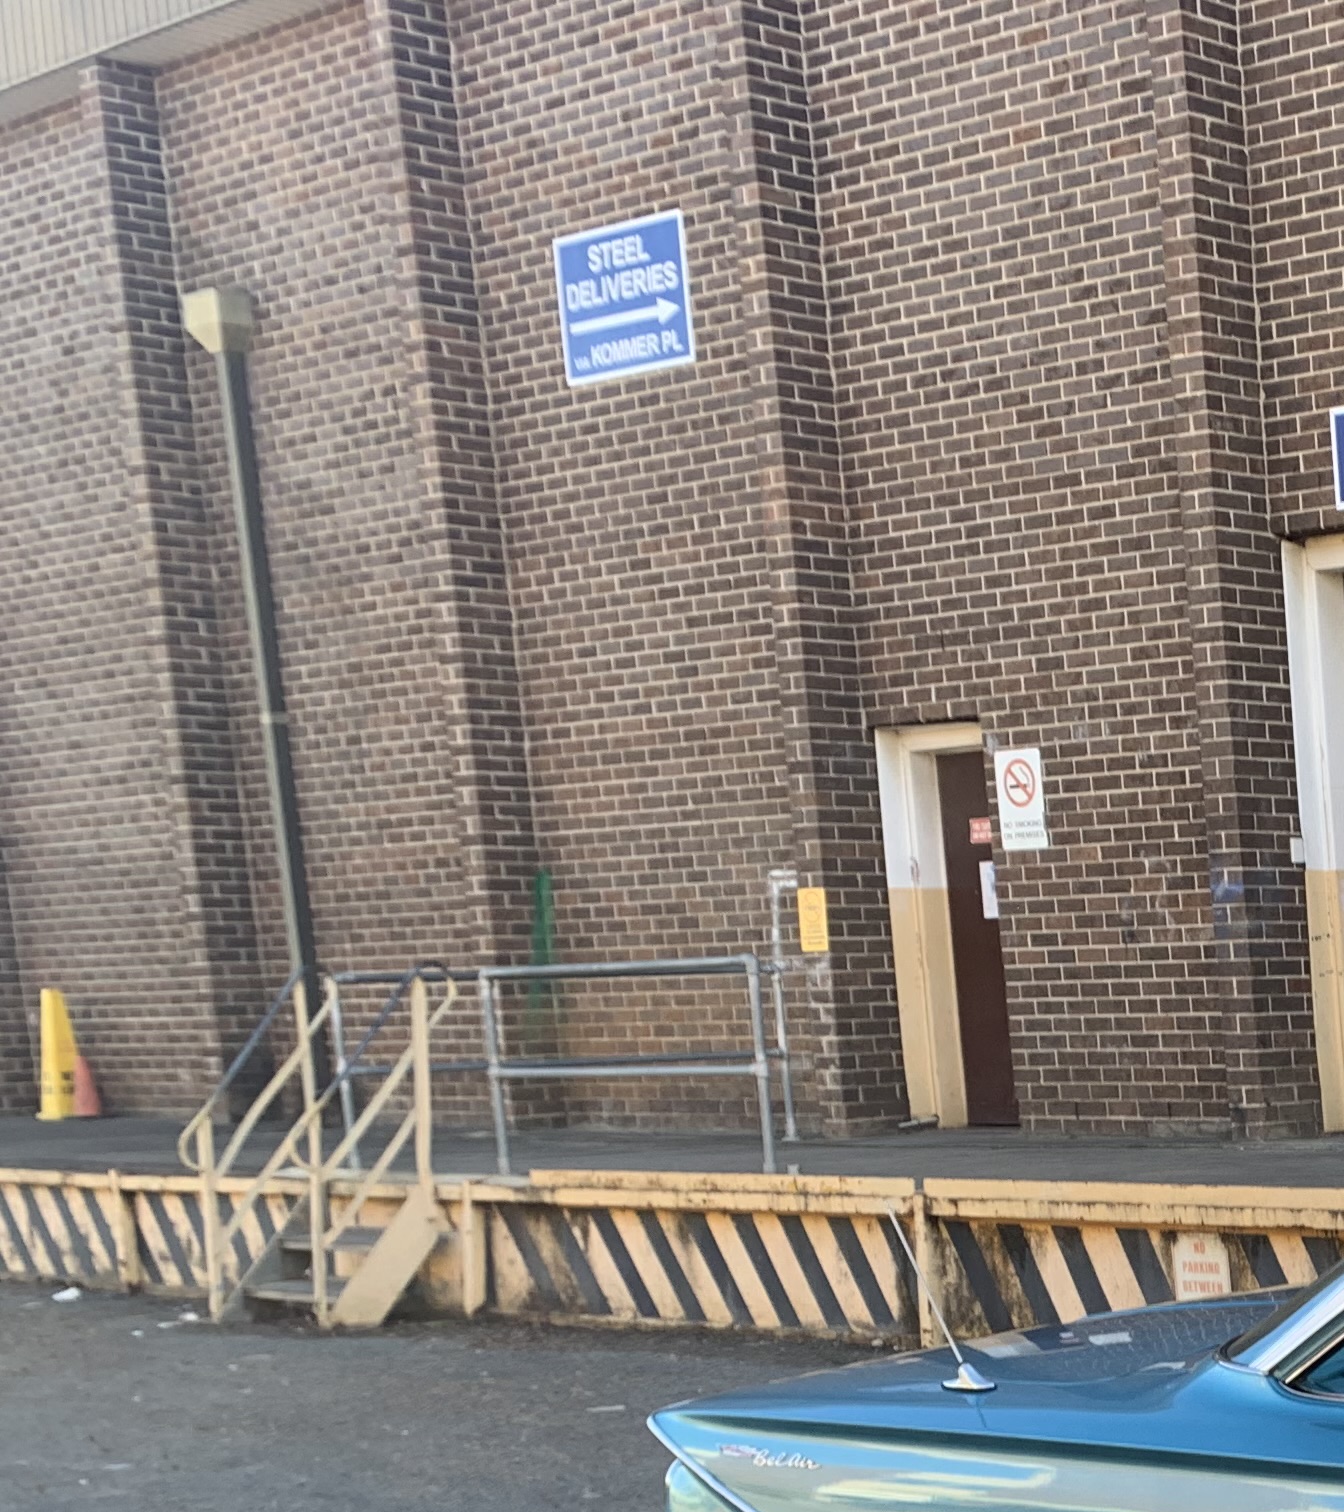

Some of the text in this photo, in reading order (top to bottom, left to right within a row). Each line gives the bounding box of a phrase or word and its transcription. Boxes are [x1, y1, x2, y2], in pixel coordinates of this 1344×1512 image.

[587, 234, 651, 274] STEEL
[565, 260, 679, 313] DELIVERIES
[590, 333, 661, 368] KOMMER
[661, 329, 684, 354] PL
[1015, 820, 1042, 828] SMOKING
[1193, 1241, 1205, 1254] NO
[1182, 1261, 1220, 1274] PARKING
[1183, 1281, 1223, 1293] BETWEEN
[753, 1448, 787, 1467] Bel
